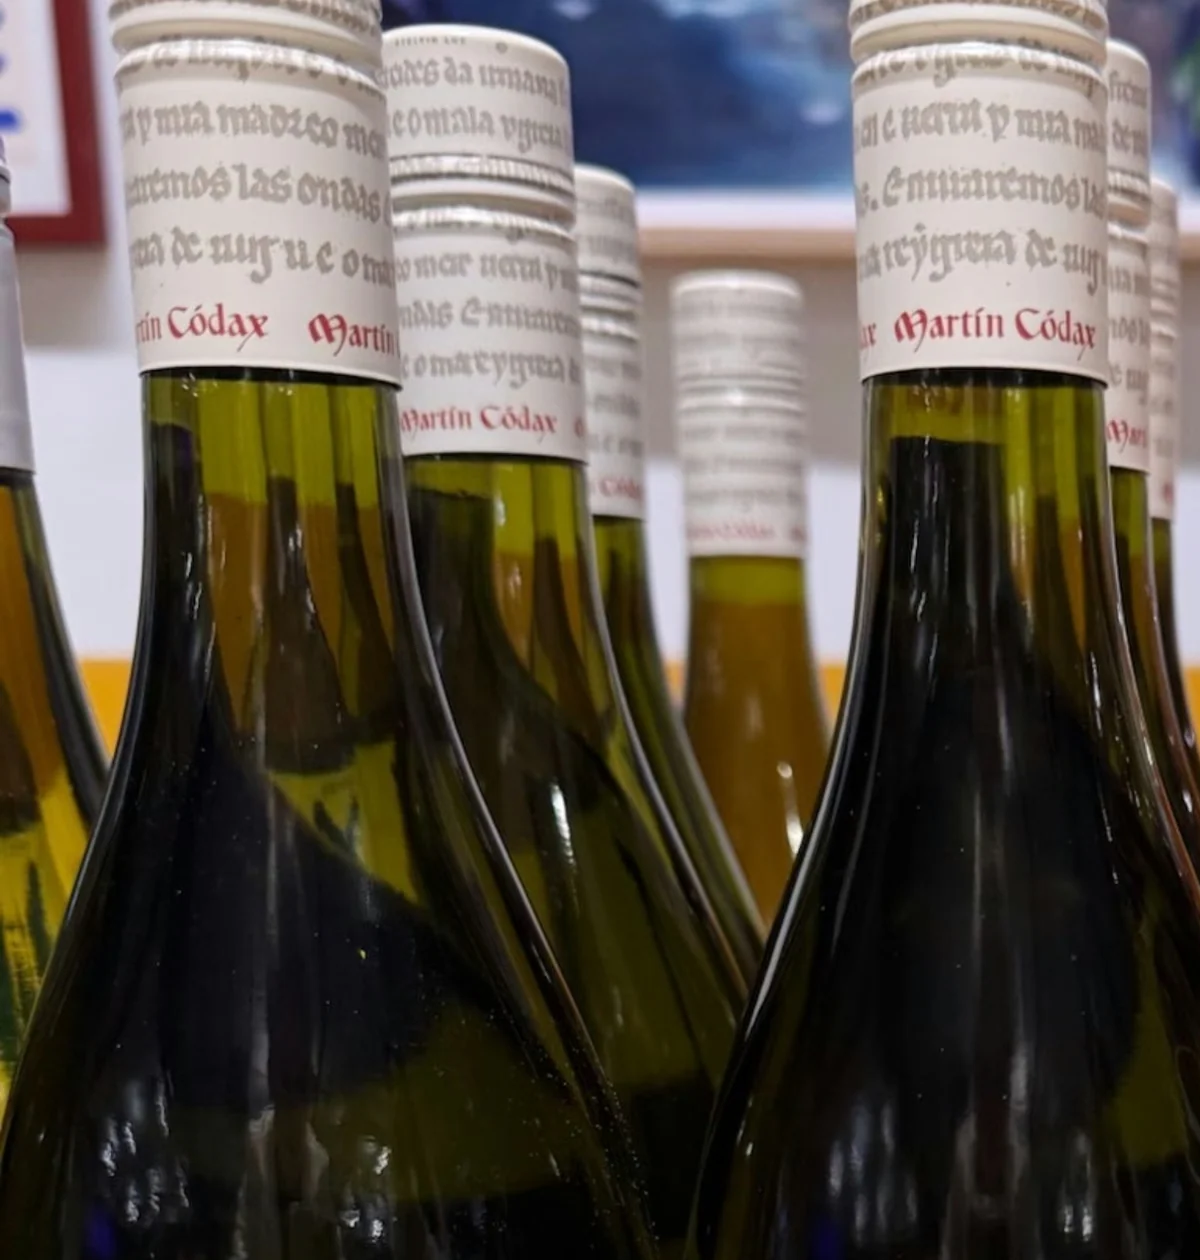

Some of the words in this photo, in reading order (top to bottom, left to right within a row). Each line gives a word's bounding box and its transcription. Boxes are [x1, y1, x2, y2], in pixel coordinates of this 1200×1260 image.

[167, 302, 269, 352] Códax
[308, 312, 396, 357] Martín
[893, 308, 1004, 353] Martín
[1014, 307, 1097, 361] Códax
[401, 406, 474, 442] Martín
[479, 406, 558, 445] Códax
